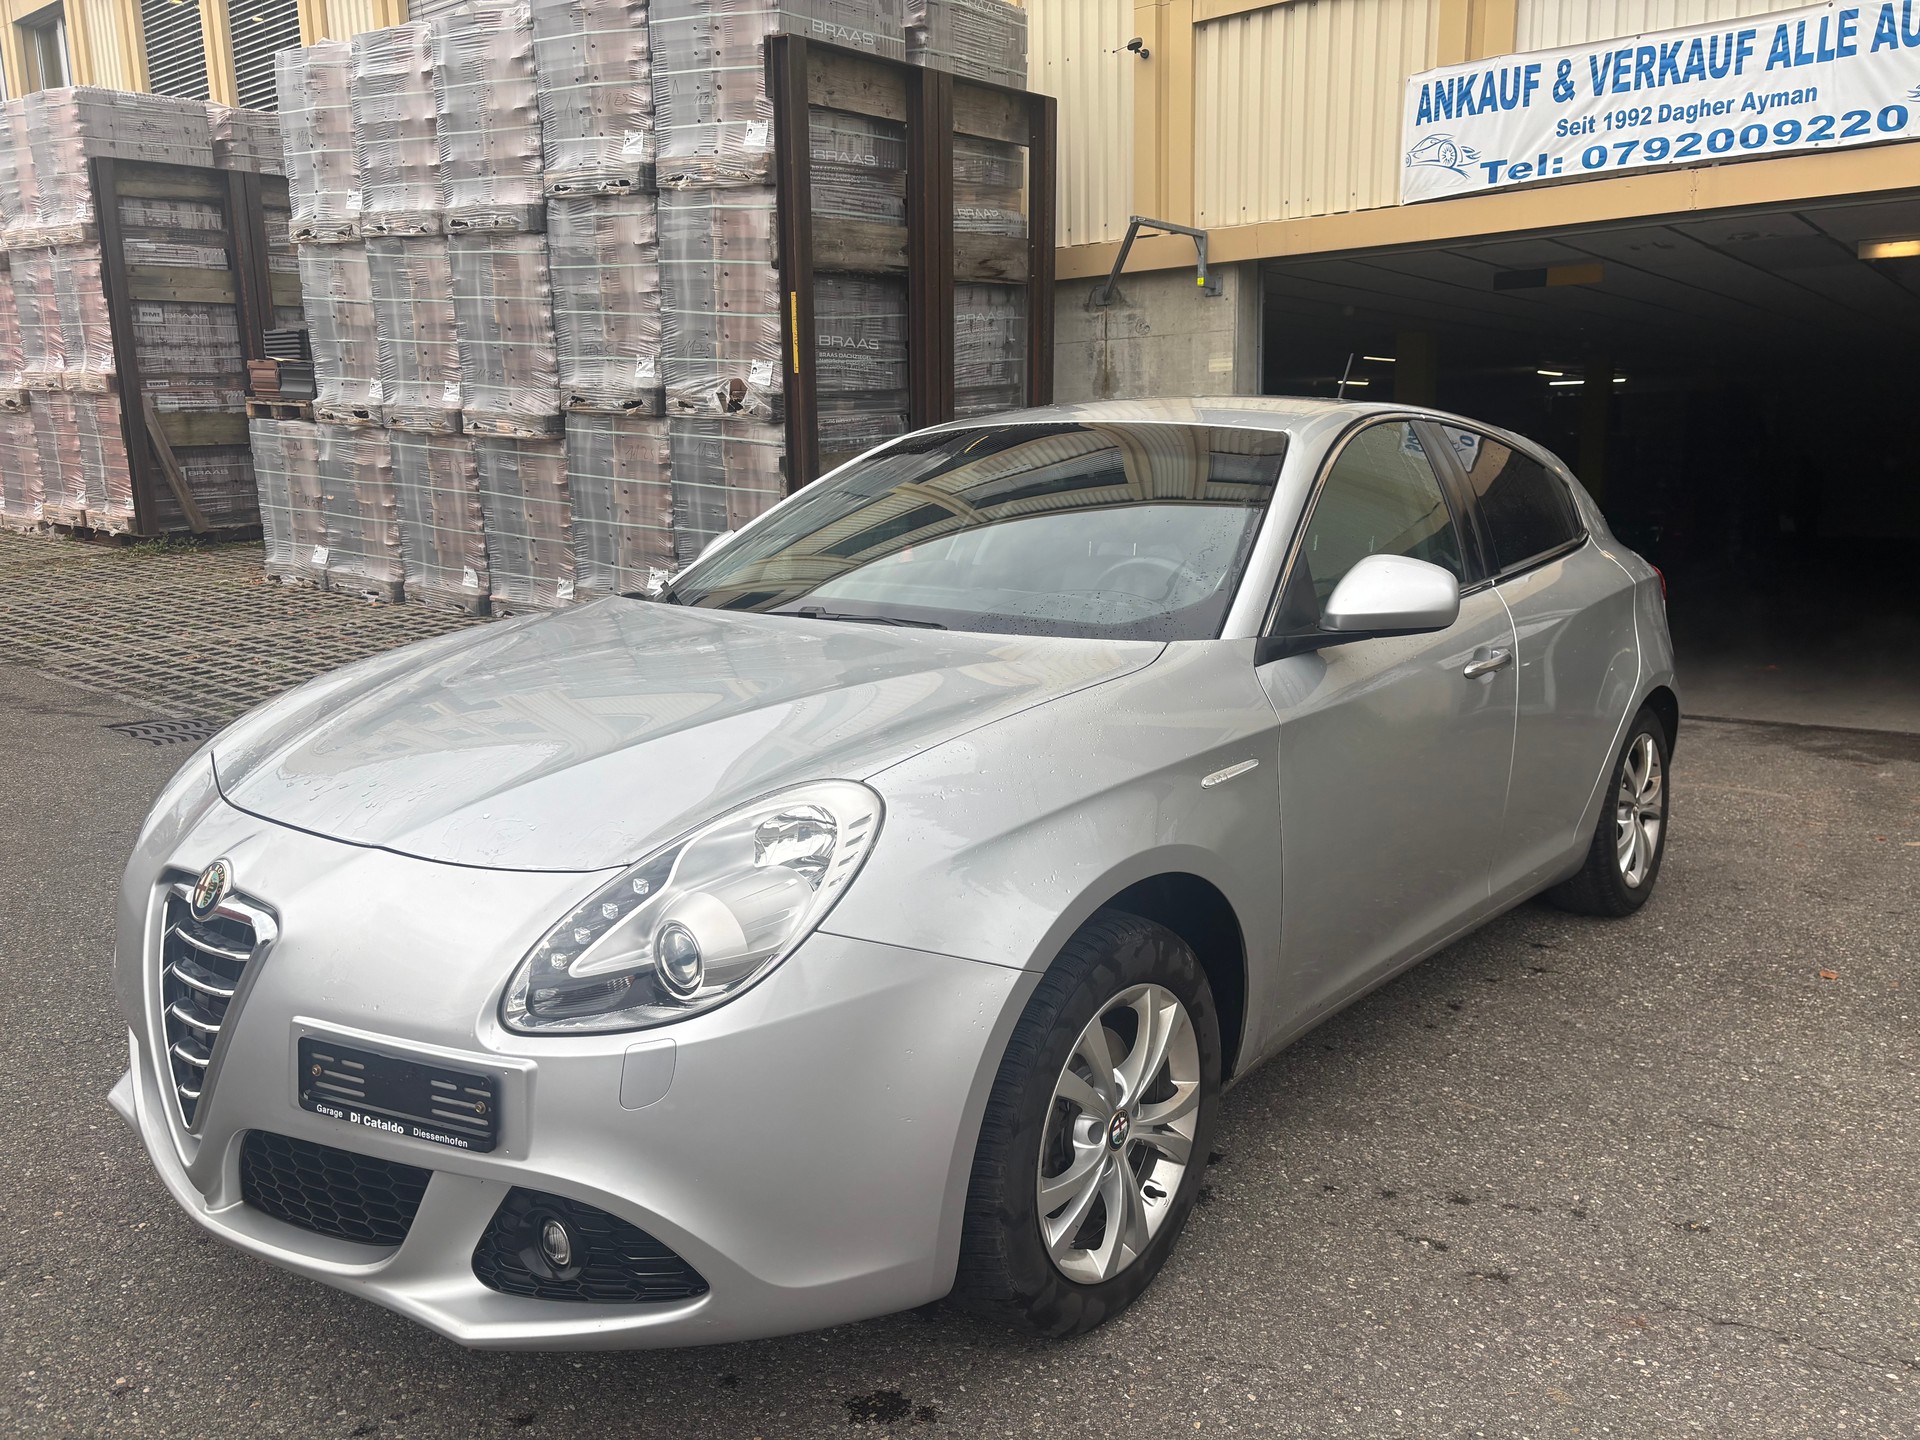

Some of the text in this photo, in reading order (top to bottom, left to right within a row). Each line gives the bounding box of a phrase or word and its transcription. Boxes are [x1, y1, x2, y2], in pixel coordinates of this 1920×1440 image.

[812, 19, 874, 45] BRAAS
[1415, 0, 1920, 127] ANKAUF & VERKAUF ALLE AU
[1556, 86, 1818, 138] Seit 1992 Dagher Ayman
[813, 150, 876, 166] BRAAS
[1480, 104, 1909, 184] Tel: 0792009220
[956, 310, 1005, 325] BRAAS
[819, 335, 879, 349] BRAAS
[316, 1103, 469, 1148] Garage Di Cataldo Diessenhofen
